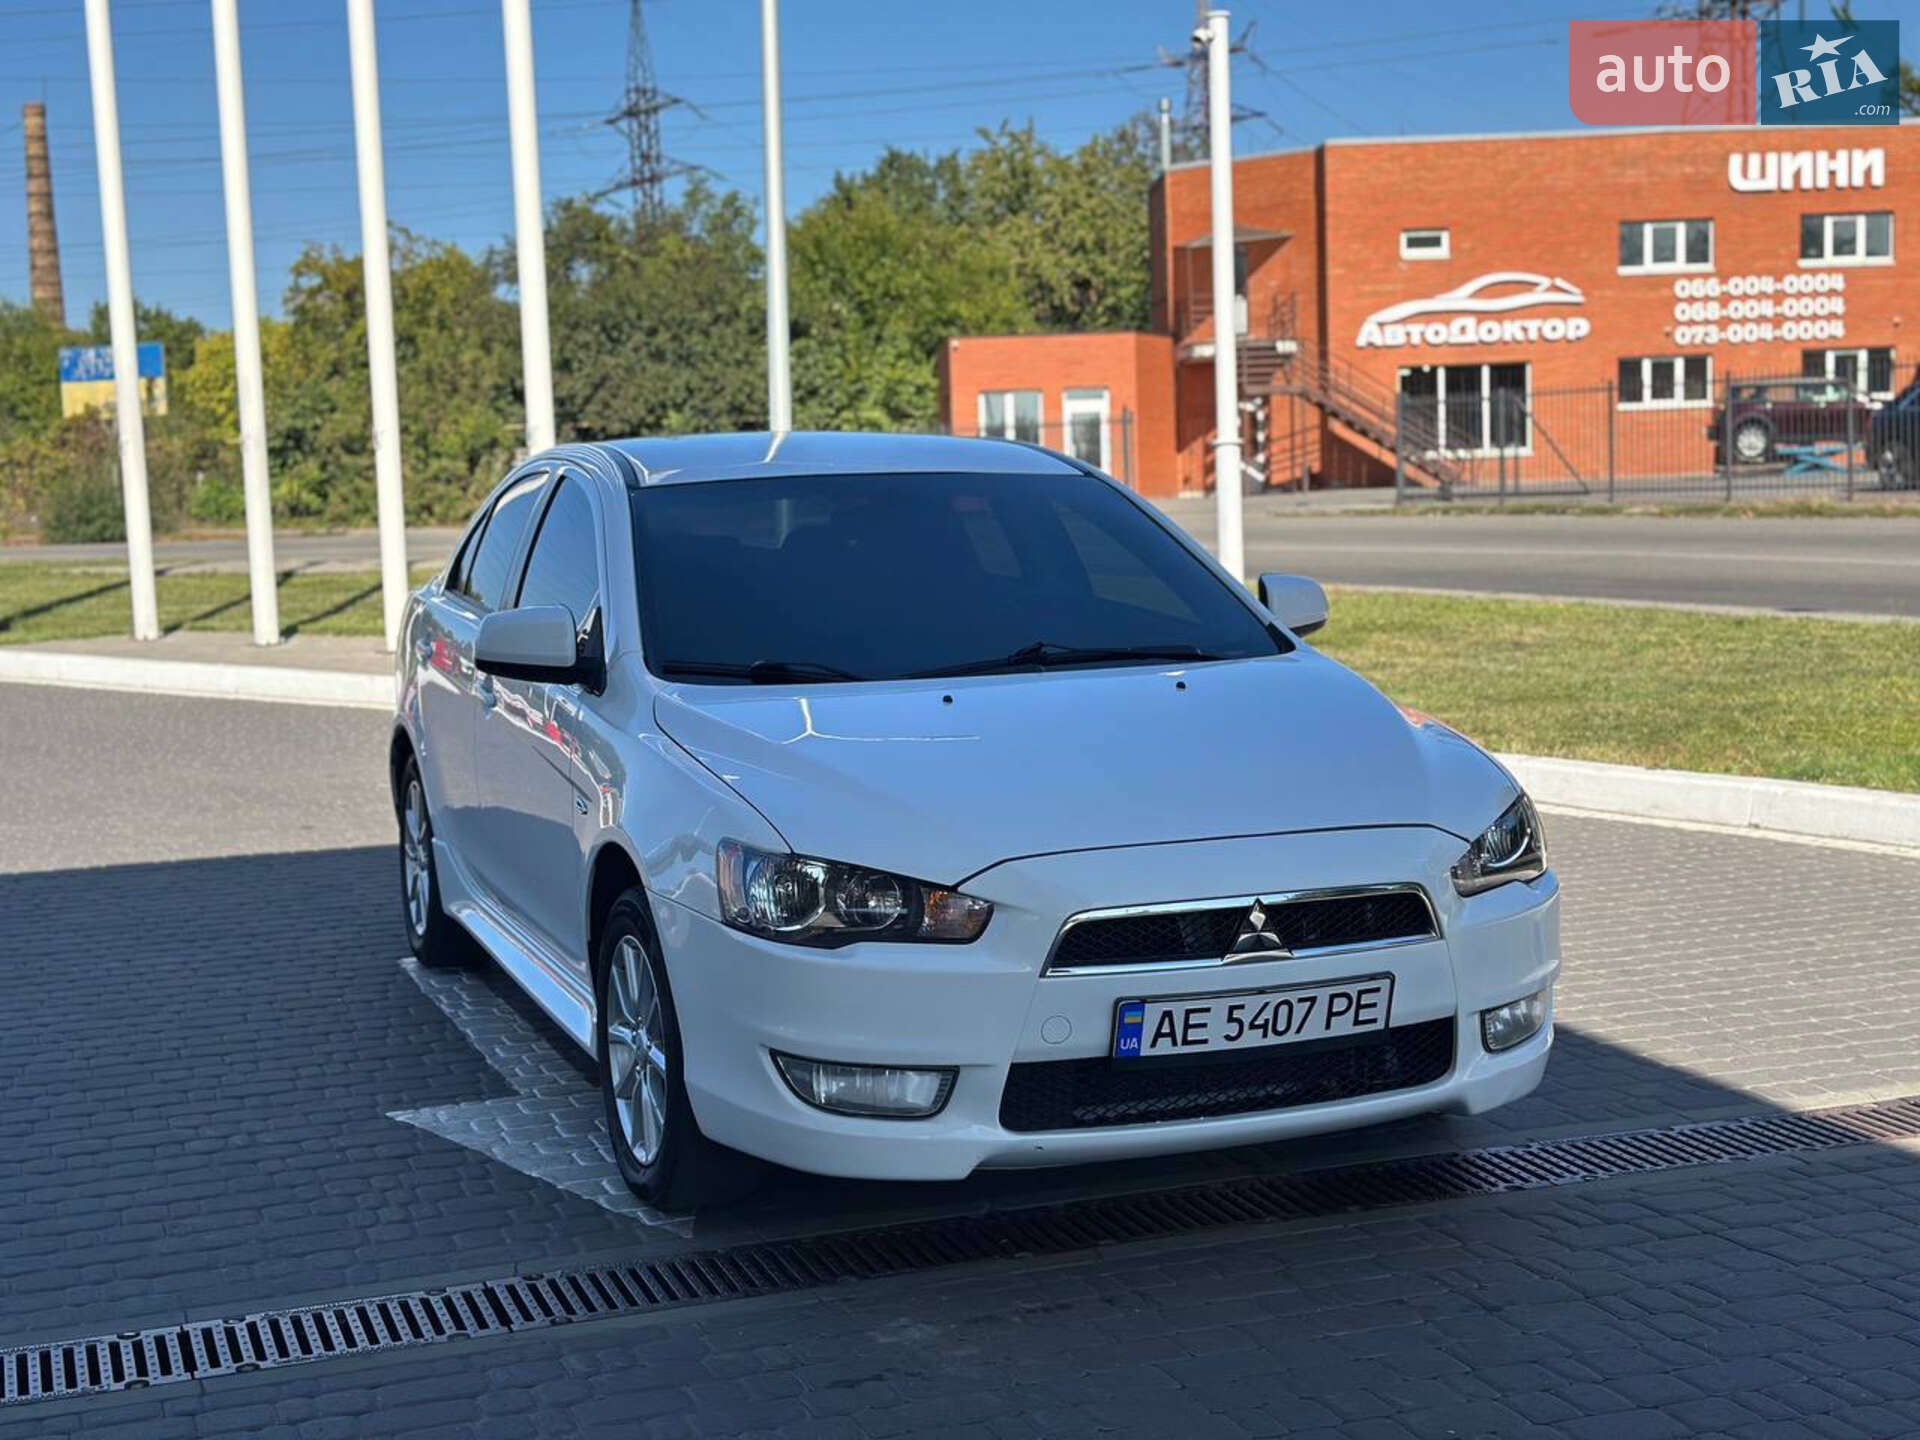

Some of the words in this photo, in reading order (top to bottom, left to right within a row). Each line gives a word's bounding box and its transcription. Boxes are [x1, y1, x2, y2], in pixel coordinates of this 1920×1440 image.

[1728, 148, 1886, 192] ШИНИ
[1149, 1006, 1212, 1049] AE
[1223, 995, 1318, 1042] 5407
[1324, 986, 1382, 1031] PE
[1120, 1037, 1139, 1051] UA
